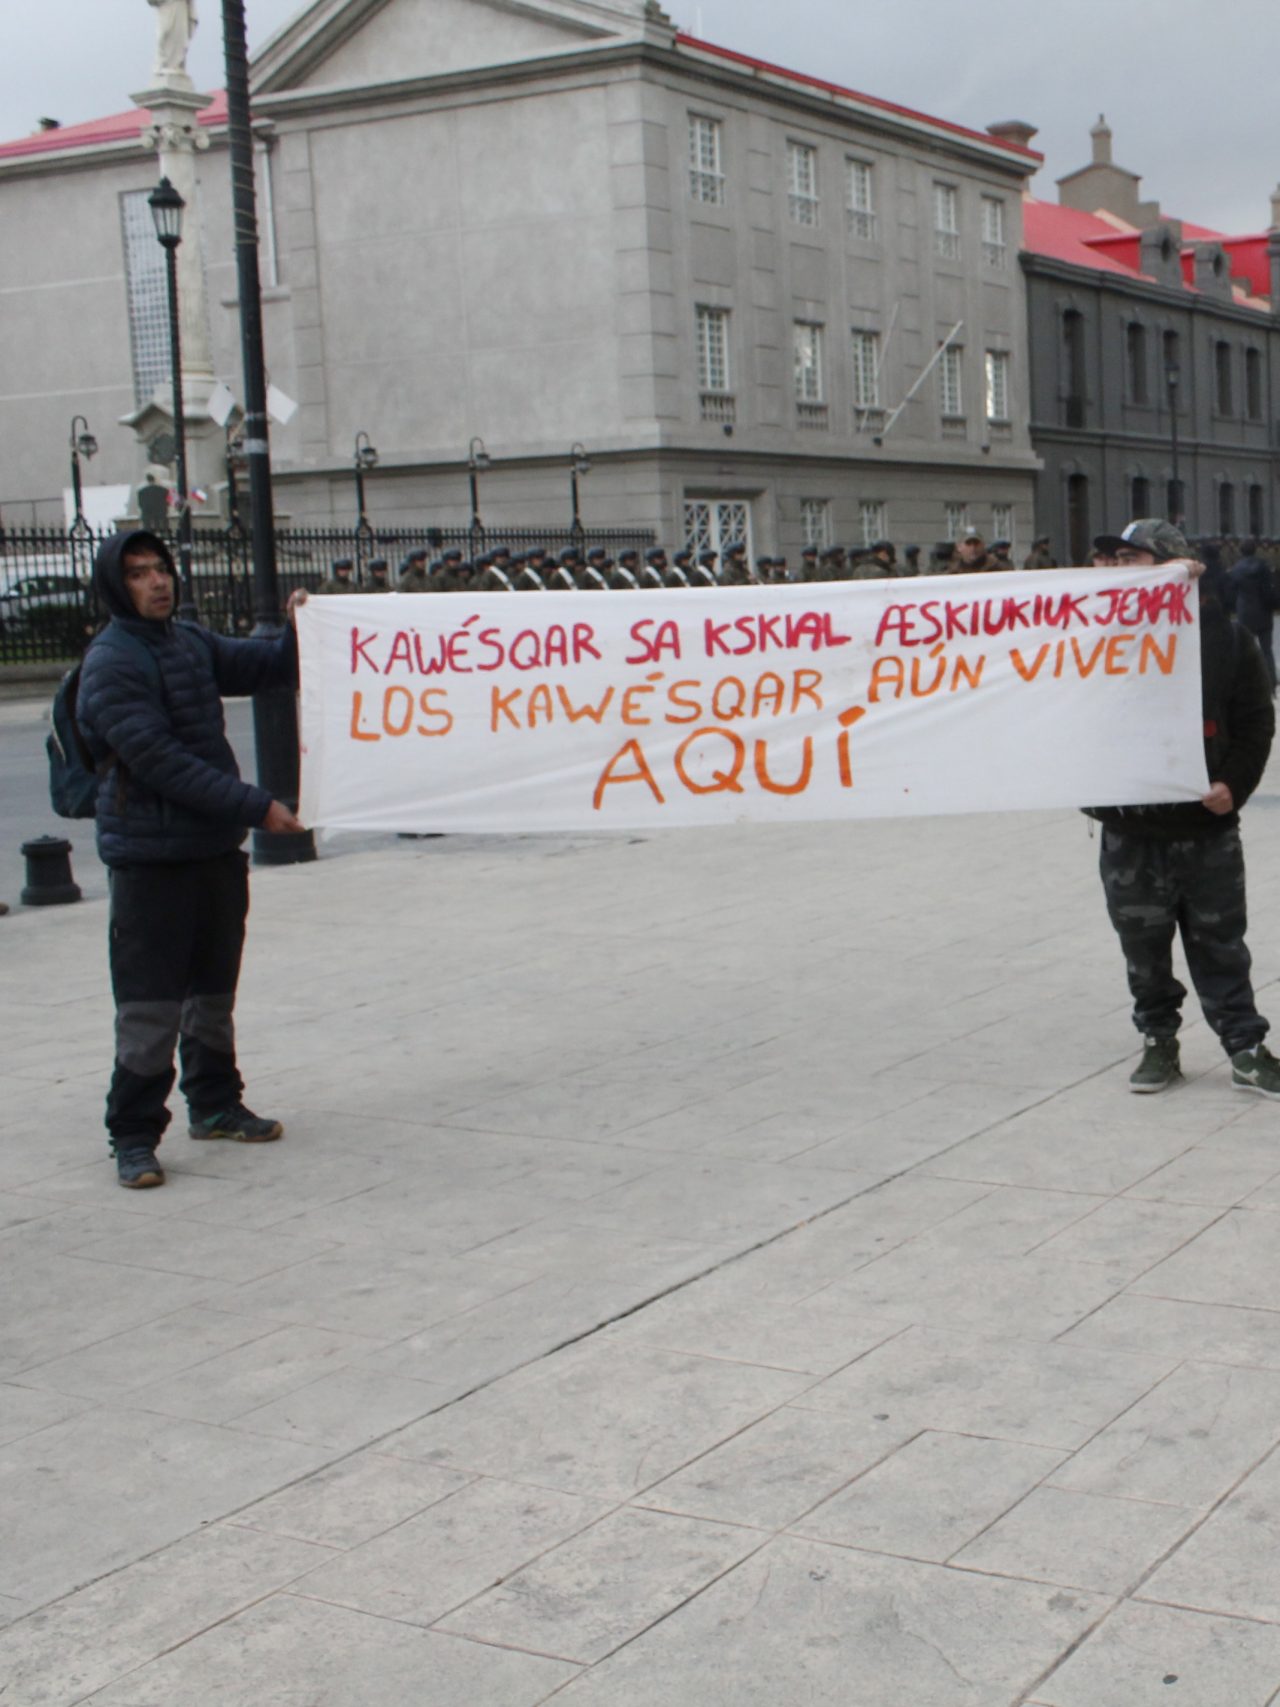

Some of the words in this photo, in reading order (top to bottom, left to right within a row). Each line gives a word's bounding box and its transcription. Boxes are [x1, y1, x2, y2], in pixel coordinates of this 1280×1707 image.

[350, 614, 602, 676] KAWÉSQAR
[625, 619, 682, 665] SA
[704, 611, 852, 658] KSKIAL
[350, 684, 454, 742] LOS
[490, 669, 824, 733] KAWÉSQAR
[867, 643, 986, 703] AÚN
[1009, 633, 1177, 682] VIVEN
[592, 705, 866, 810] AQUÍ
